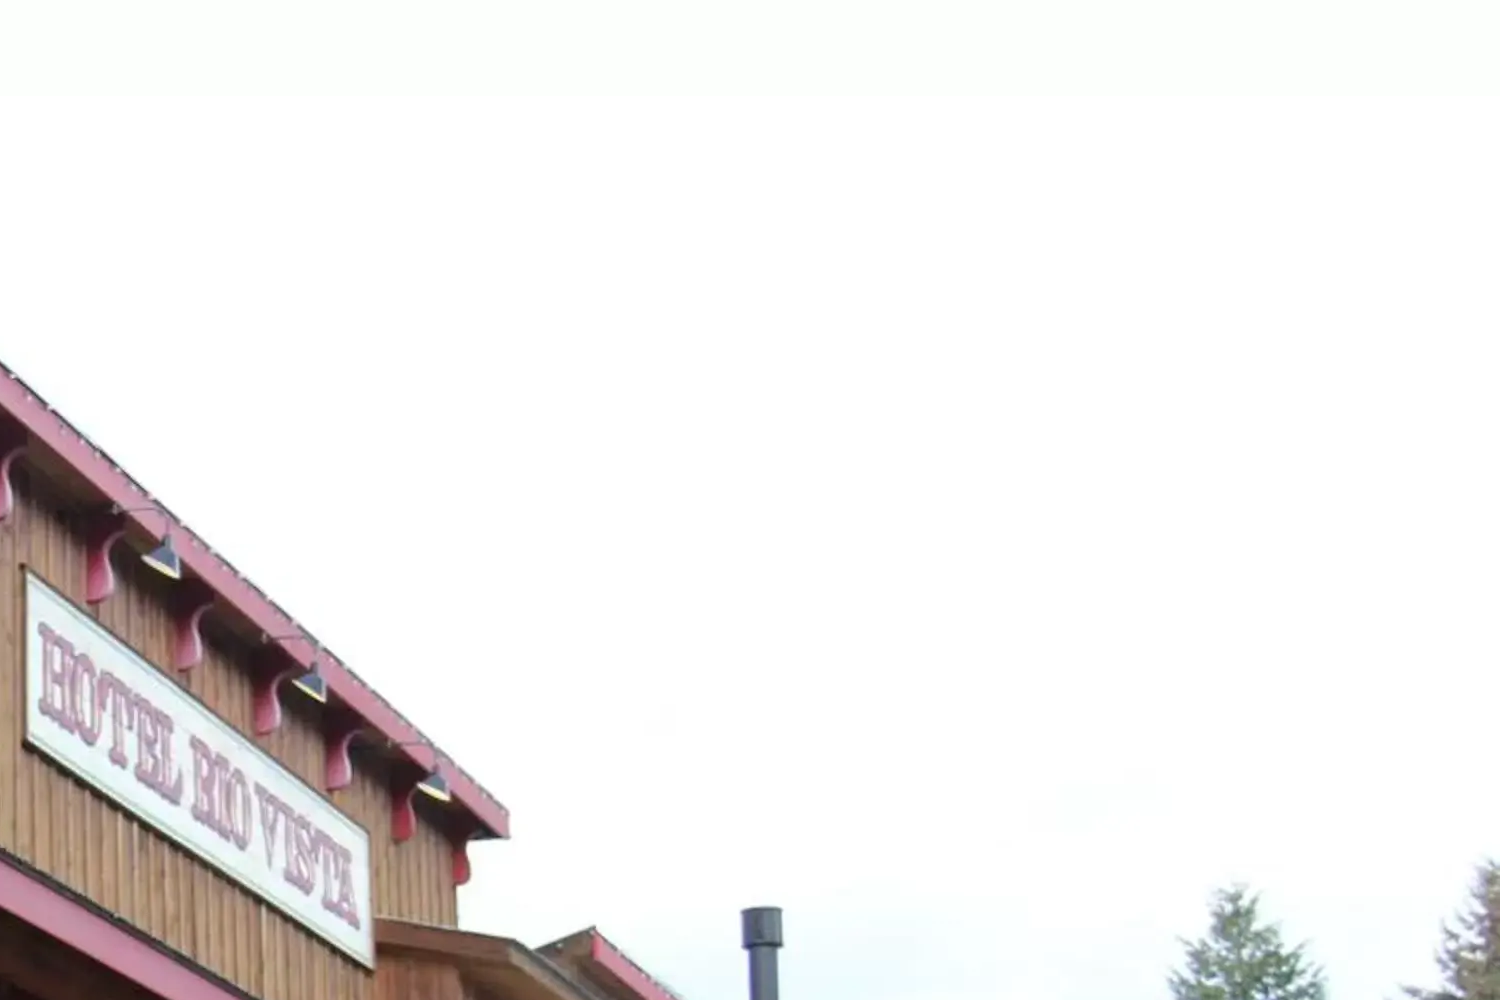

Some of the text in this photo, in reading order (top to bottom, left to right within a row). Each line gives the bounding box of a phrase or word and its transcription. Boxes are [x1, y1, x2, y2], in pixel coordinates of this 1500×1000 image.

[38, 622, 361, 930] HOTEL RIO VISTA
